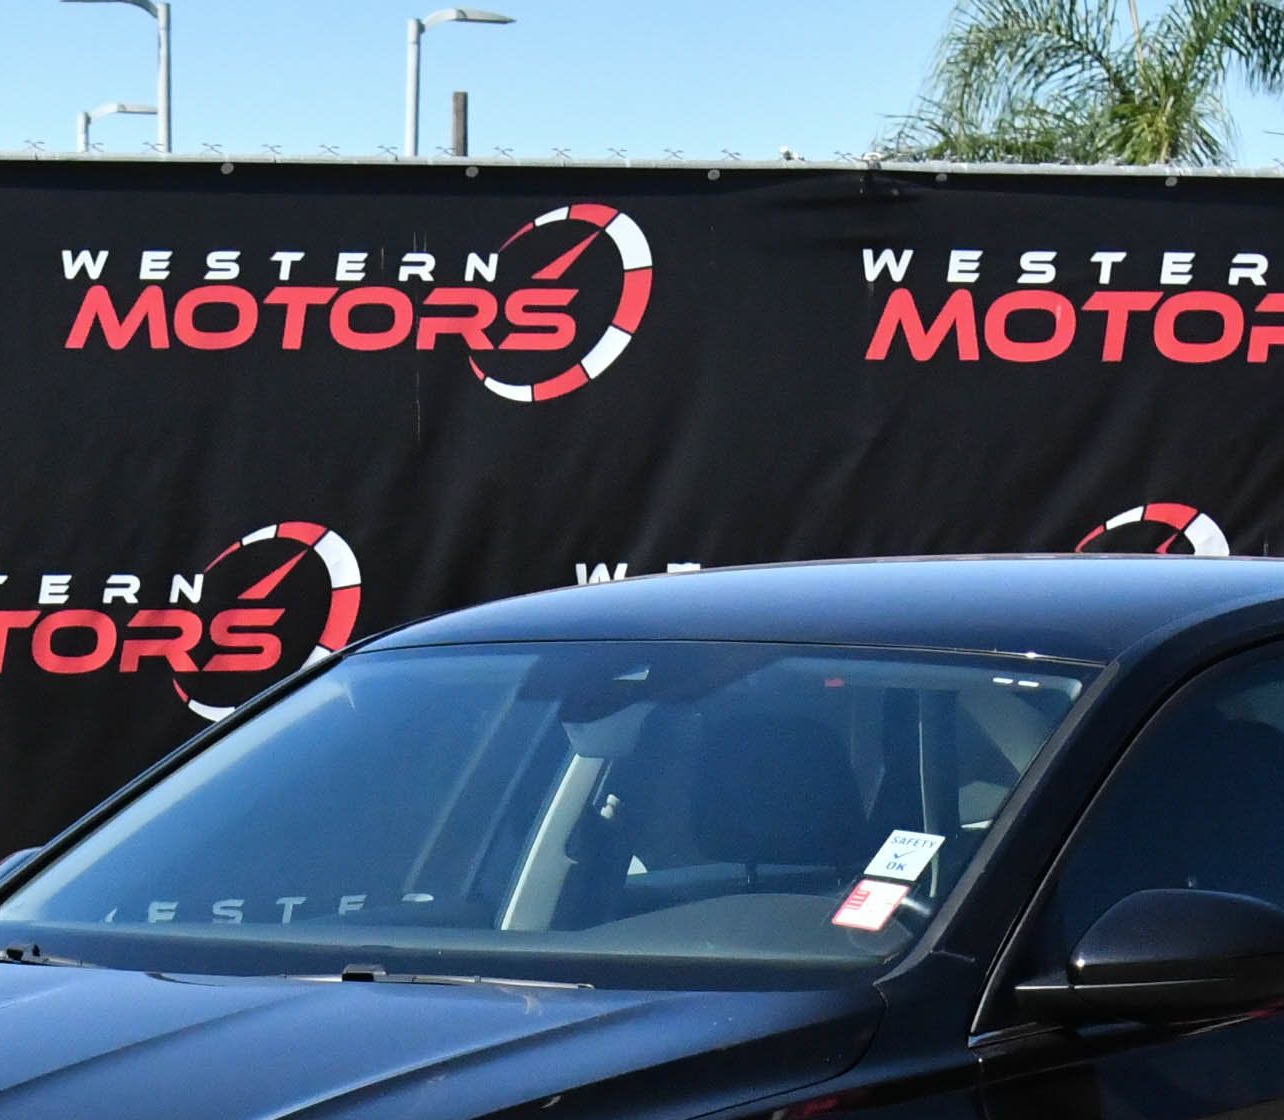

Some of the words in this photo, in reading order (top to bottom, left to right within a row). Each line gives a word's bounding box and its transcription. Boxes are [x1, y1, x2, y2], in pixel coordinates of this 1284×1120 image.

[61, 249, 499, 282] WESTERN
[65, 284, 579, 352] MOTORS
[891, 836, 937, 849] SAFETY
[886, 861, 907, 871] OK
